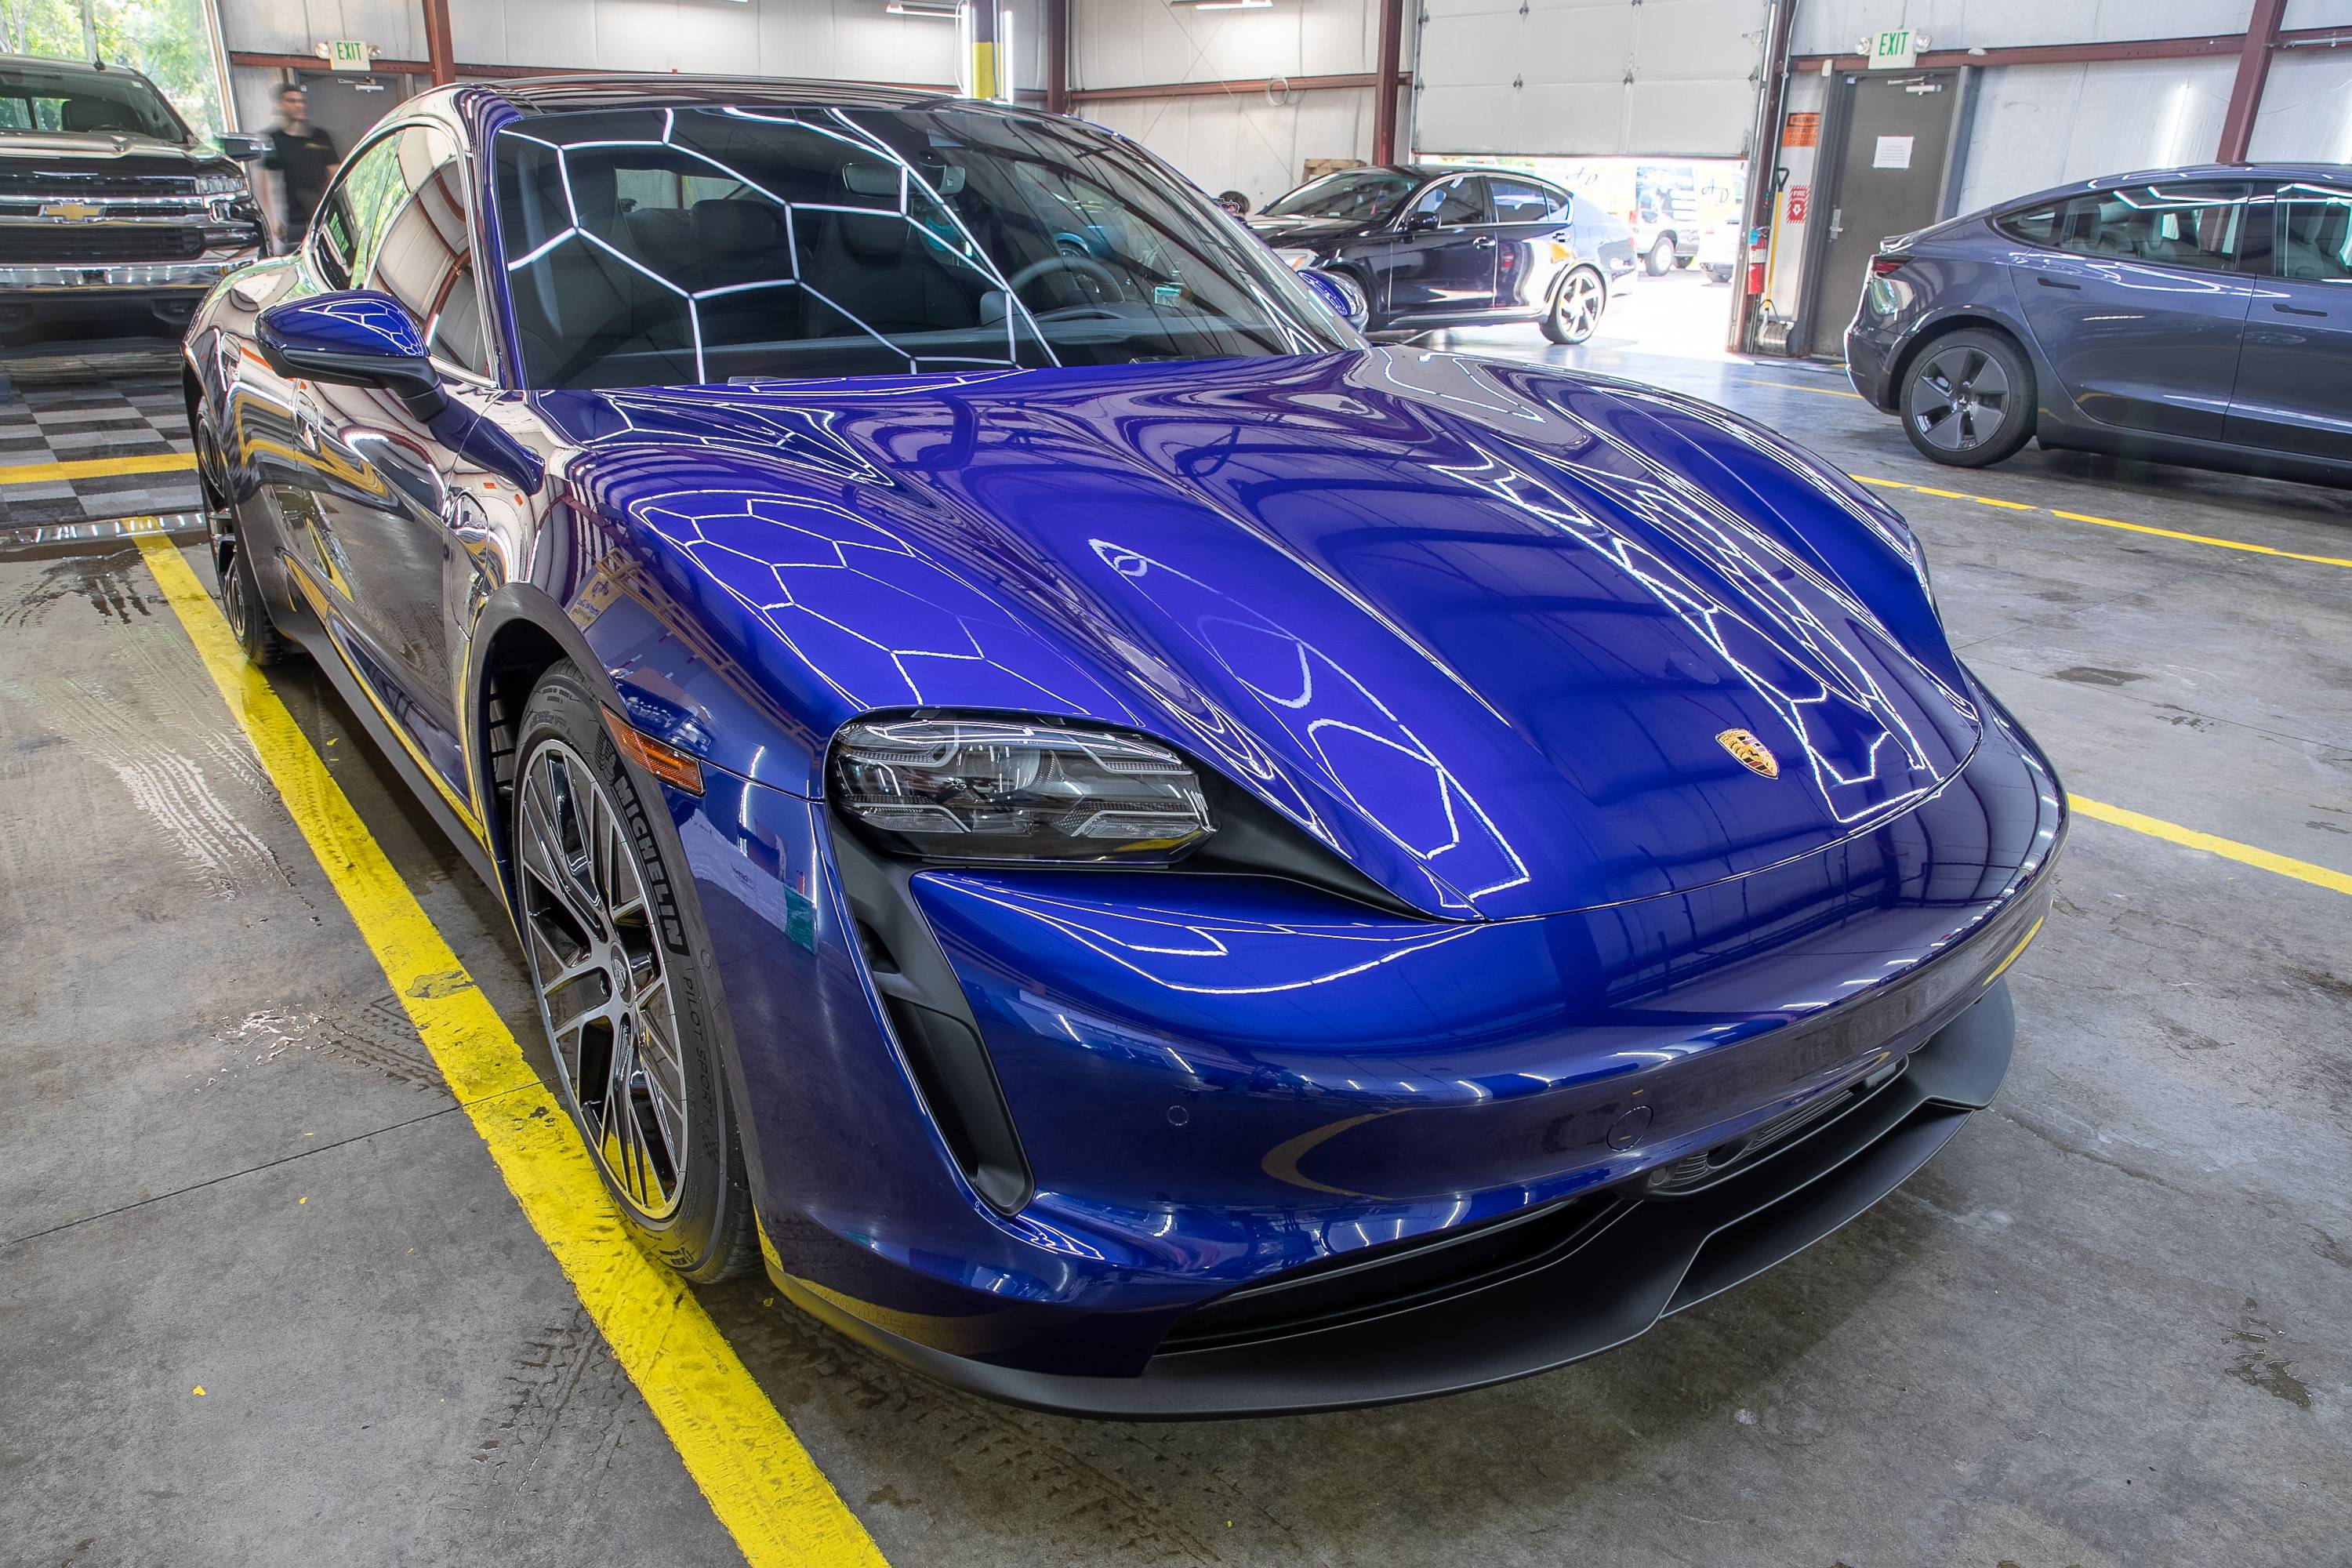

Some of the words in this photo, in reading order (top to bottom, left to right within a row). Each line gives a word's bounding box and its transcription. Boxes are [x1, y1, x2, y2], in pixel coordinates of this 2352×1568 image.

[336, 42, 361, 60] EXIT
[1878, 32, 1909, 56] EXIT
[613, 775, 684, 946] MICHELIN
[683, 976, 703, 1041] PILOT
[696, 1047, 713, 1119] SPORT
